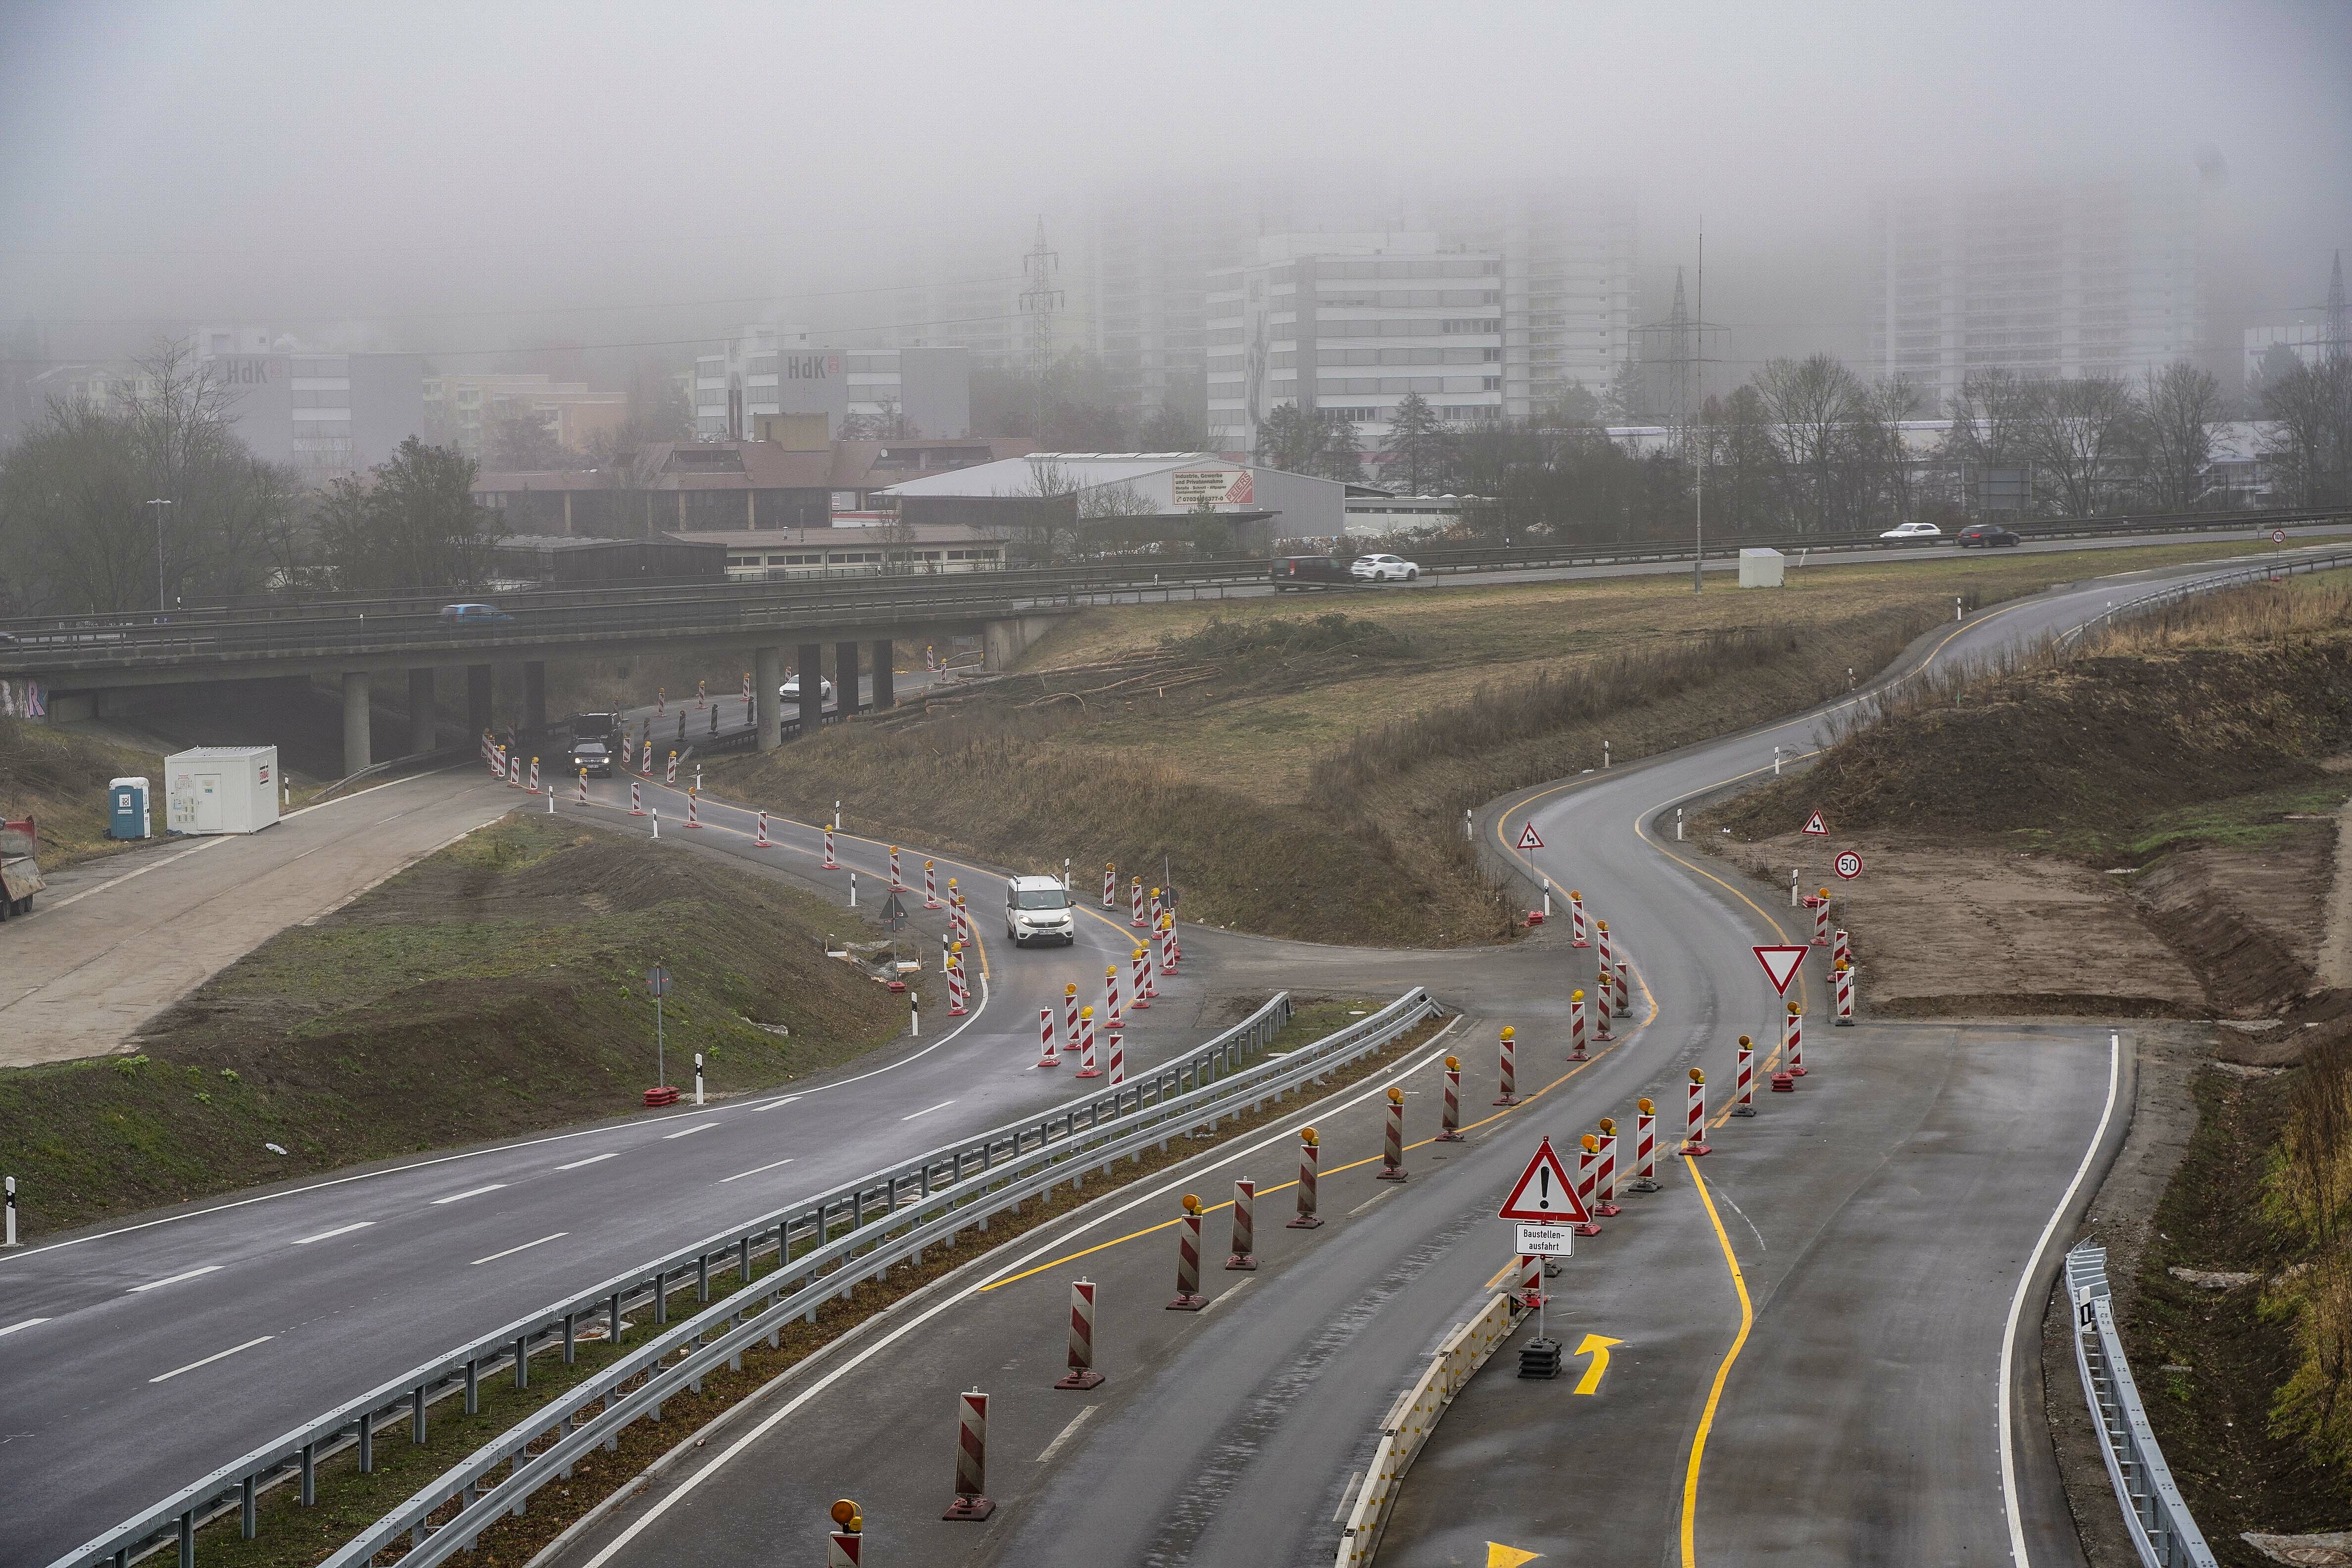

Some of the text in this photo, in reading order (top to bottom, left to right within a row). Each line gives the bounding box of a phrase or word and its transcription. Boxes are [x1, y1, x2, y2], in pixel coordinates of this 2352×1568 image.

[788, 356, 826, 379] HdK
[1841, 858, 1857, 871] 50
[1523, 1229, 1565, 1239] Baustellen-
[1529, 1242, 1559, 1251] ausfahrt
